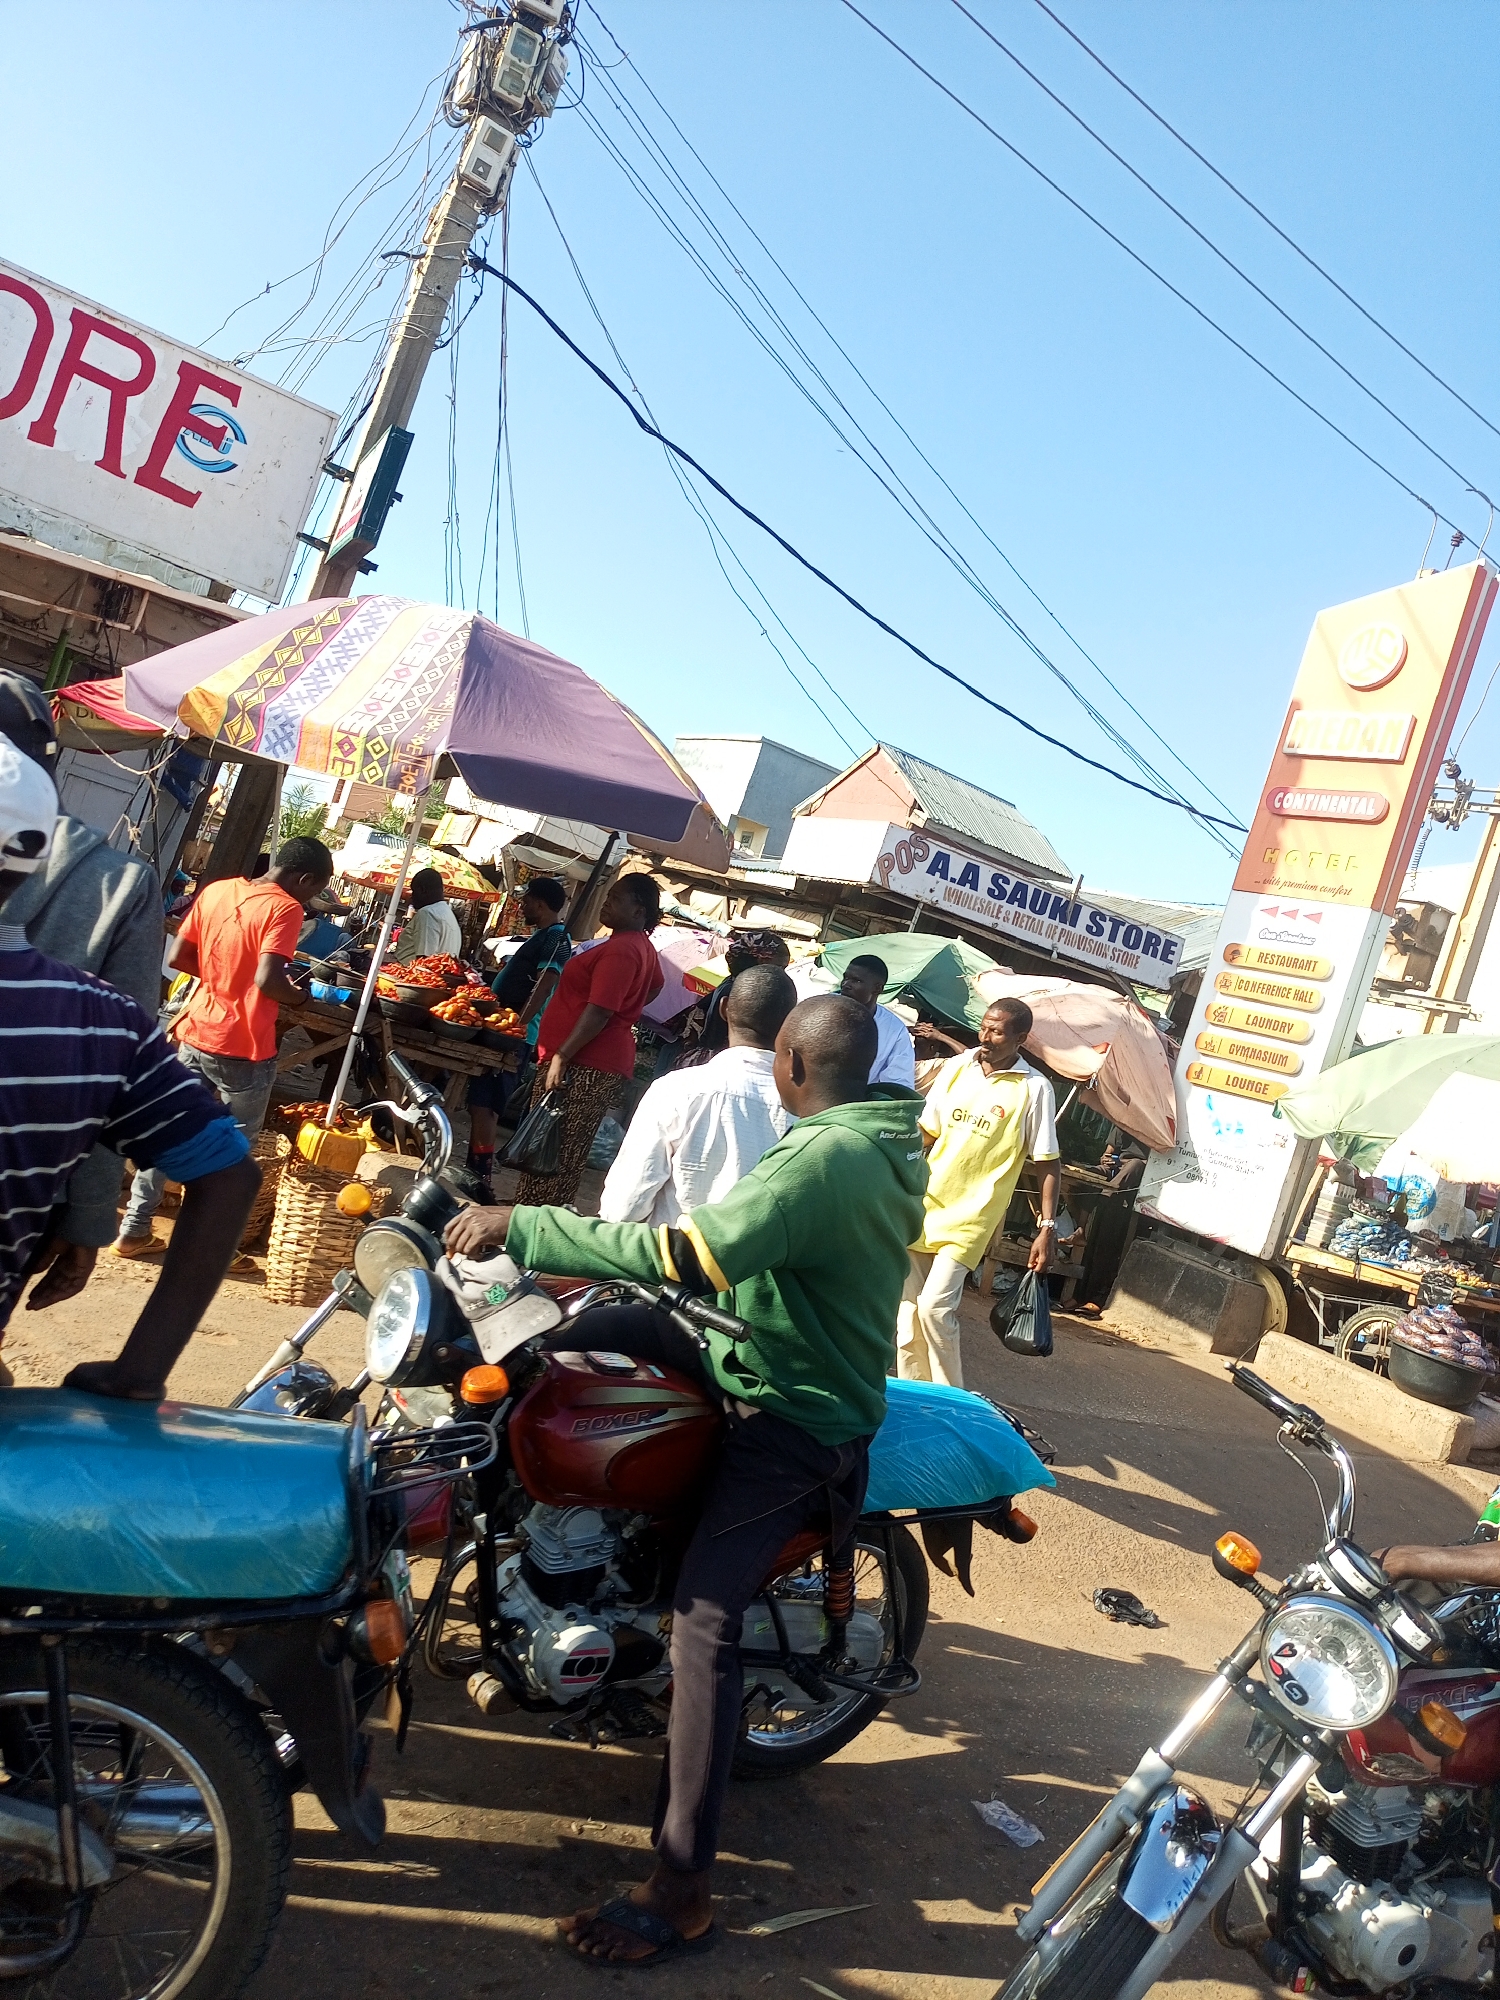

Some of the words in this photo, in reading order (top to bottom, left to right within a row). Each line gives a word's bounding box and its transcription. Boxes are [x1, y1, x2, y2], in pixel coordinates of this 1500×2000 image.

[1273, 791, 1376, 816] CONTINENTAL
[877, 832, 930, 889] POS
[1279, 879, 1319, 892] premium
[1319, 884, 1353, 898] comfort
[925, 850, 981, 892] A.A
[986, 872, 1083, 928] SAUKI
[1085, 910, 1179, 965] STORE
[943, 885, 1004, 921] WHOLESALE
[1011, 910, 1045, 937] RETAIL
[1057, 927, 1112, 958] PROVISION
[1110, 945, 1141, 970] STORE
[1256, 951, 1319, 973] RESTAURANT
[1237, 978, 1293, 1000] CONFERENCE
[1292, 990, 1314, 1004] HALL
[1245, 1013, 1295, 1035] LAUNDRY
[1228, 1043, 1289, 1068] GYMNASIUM
[1224, 1074, 1270, 1096] LOUNGE
[570, 1409, 651, 1434] BOXER
[1405, 1683, 1478, 1713] BOXER
